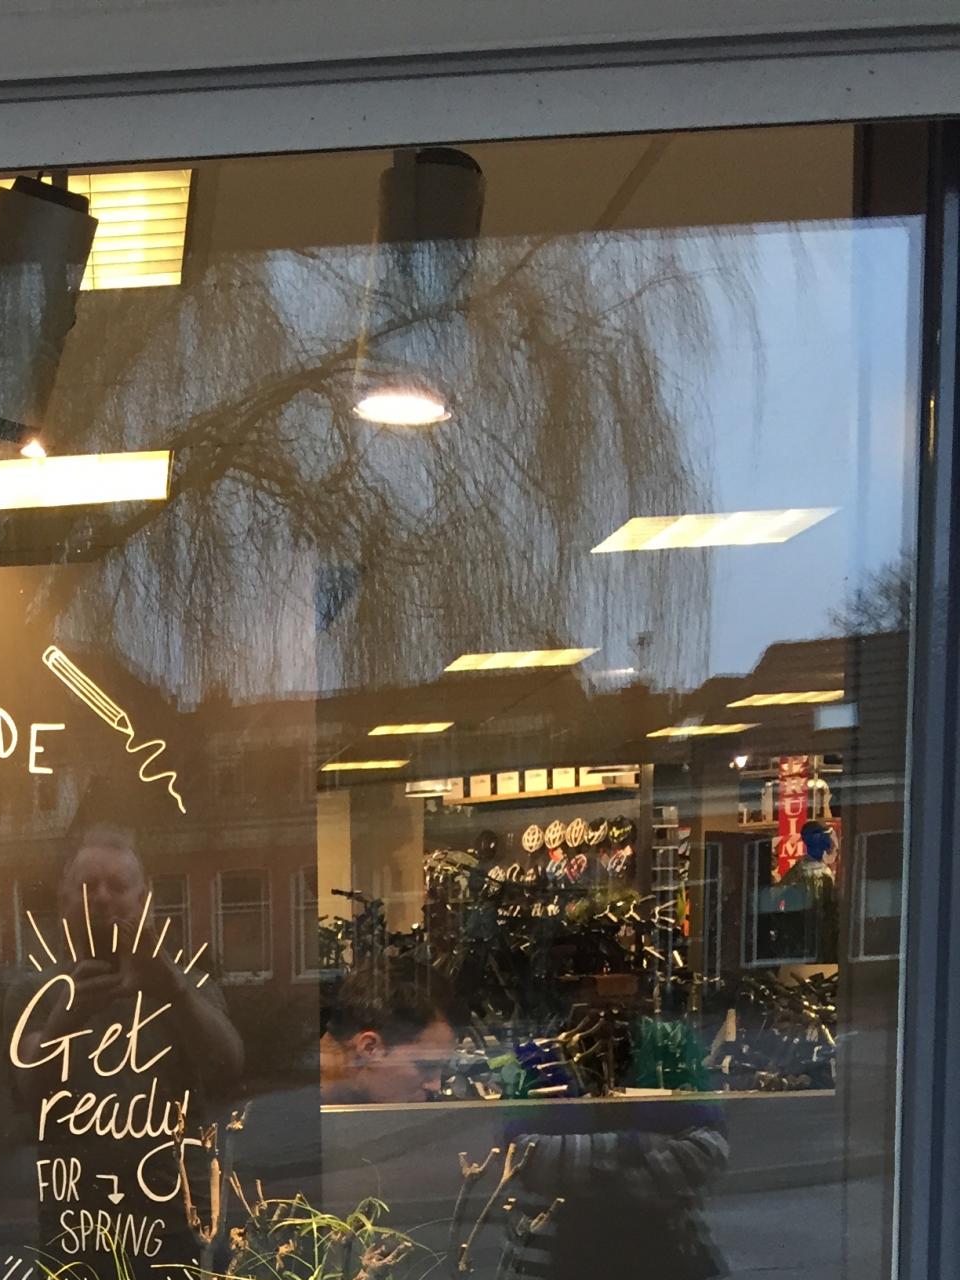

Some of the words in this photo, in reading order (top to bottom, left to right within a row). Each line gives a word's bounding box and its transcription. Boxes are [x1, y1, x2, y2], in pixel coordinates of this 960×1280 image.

[9, 974, 172, 1082] Get
[36, 1157, 82, 1203] FOR
[59, 1208, 166, 1257] SPRING
